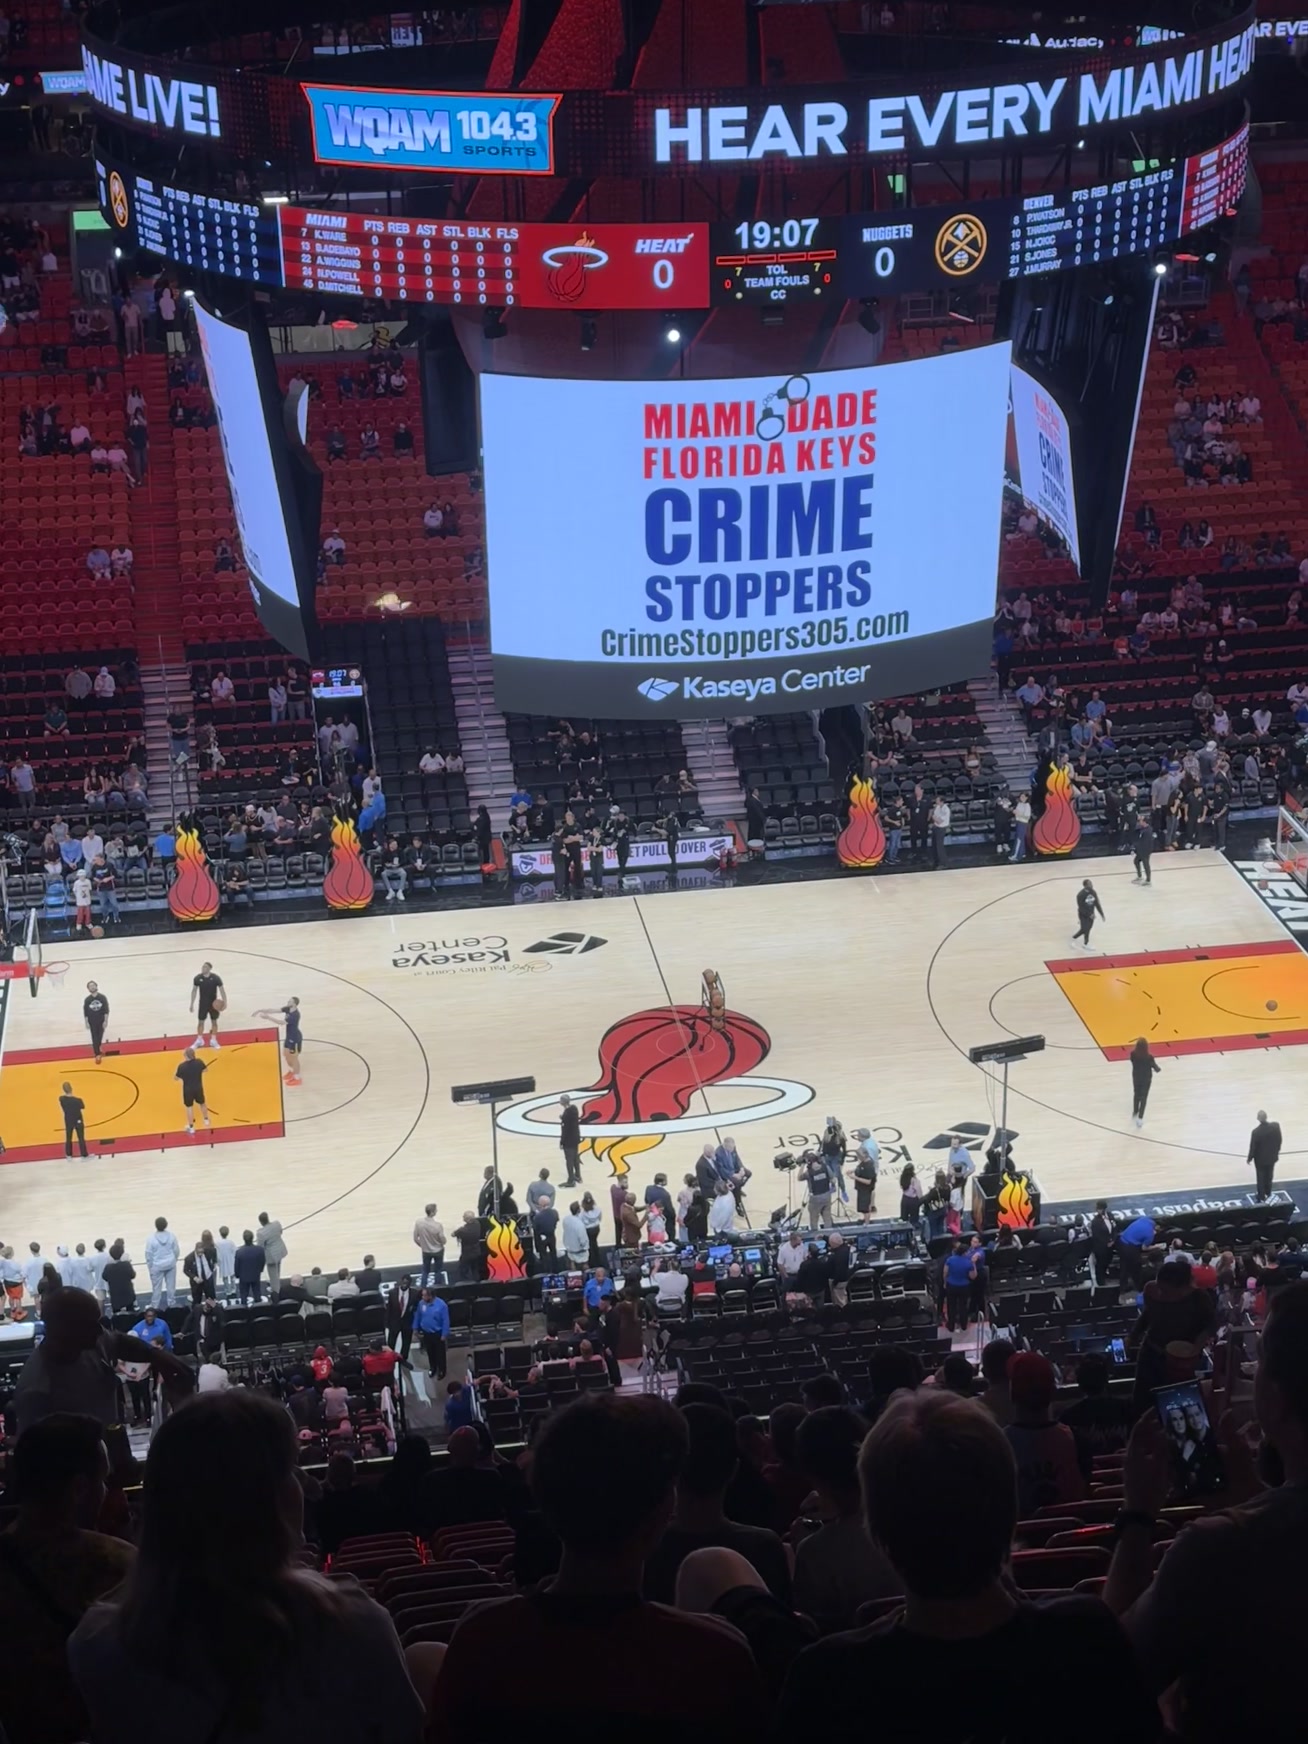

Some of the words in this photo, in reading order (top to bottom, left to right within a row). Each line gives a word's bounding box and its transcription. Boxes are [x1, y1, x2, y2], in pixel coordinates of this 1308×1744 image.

[128, 69, 221, 137] LIVE!
[654, 101, 849, 163] HEAR
[867, 77, 1068, 154] EVERY
[1078, 50, 1204, 126] MIAMI
[323, 103, 452, 156] WQAM
[456, 110, 538, 142] 104.3
[463, 145, 538, 157] SPORTS
[1023, 194, 1054, 211] DENVER
[1072, 189, 1089, 202] PTS
[1091, 185, 1108, 198] REB
[1111, 181, 1127, 194] AST
[1129, 178, 1144, 190] STL
[1144, 173, 1159, 186] BLK
[1161, 169, 1174, 181] FLS
[223, 201, 241, 215] BLK
[243, 204, 260, 217] FLS
[1013, 215, 1020, 225] 8
[305, 213, 348, 229] MIAMI
[364, 220, 384, 233] PTS
[388, 221, 410, 234] REB
[416, 224, 437, 236] AST
[443, 226, 464, 238] STL
[468, 227, 491, 239] BLK
[496, 228, 519, 240] FLS
[735, 218, 819, 249] 19:07
[862, 223, 914, 243] NUGGETS
[1011, 228, 1021, 238] 10
[301, 228, 307, 237] 7
[371, 235, 379, 246] 0
[395, 236, 404, 248] 0
[423, 238, 431, 249] 0
[450, 240, 459, 251] 0
[476, 241, 484, 252] 0
[503, 242, 512, 253] 0
[634, 232, 695, 254] HEAT
[1011, 241, 1020, 251] 15
[301, 253, 312, 263] 22
[373, 261, 381, 272] 0
[397, 263, 405, 274] 0
[424, 265, 433, 276] 0
[452, 266, 460, 277] 0
[477, 268, 485, 278] 0
[504, 269, 513, 280] 0
[372, 248, 380, 259] 0
[396, 250, 404, 261] 0
[423, 252, 432, 263] 0
[451, 254, 459, 265] 0
[476, 255, 485, 266] 0
[504, 256, 512, 267] 0
[875, 247, 895, 277] 0
[1010, 254, 1020, 264] 21
[1024, 247, 1057, 262] S.JONES
[652, 259, 675, 290] 0
[735, 267, 743, 277] 7
[766, 265, 788, 275] TOL
[813, 263, 821, 273] 7
[1009, 267, 1019, 277] 27
[374, 274, 382, 285] 0
[398, 276, 406, 287] 0
[425, 277, 433, 289] 0
[453, 279, 461, 291] 0
[478, 281, 486, 292] 0
[505, 282, 514, 293] 0
[724, 279, 732, 290] 0
[744, 276, 774, 288] TEAM
[776, 274, 810, 287] FOULS
[824, 273, 831, 284] 0
[374, 286, 383, 297] 0
[399, 288, 407, 299] 0
[426, 290, 434, 301] 0
[453, 292, 462, 303] 0
[478, 293, 487, 304] 0
[506, 294, 514, 305] 0
[770, 290, 787, 300] CC
[643, 400, 756, 440] MIAMI
[787, 388, 878, 434] DADE
[643, 441, 786, 480] FLORIDA
[797, 431, 876, 473] KEYS
[645, 473, 874, 566] CRIME
[645, 560, 872, 622] STOPPERS
[601, 609, 909, 659] CrimeStoppers305.com
[683, 675, 776, 701] Kaseya
[781, 664, 871, 693] Center
[642, 843, 679, 857] PULLD
[681, 841, 707, 854] OVER
[393, 935, 508, 953] Center
[392, 949, 511, 968] Kaseya
[774, 1126, 903, 1149] Ceter
